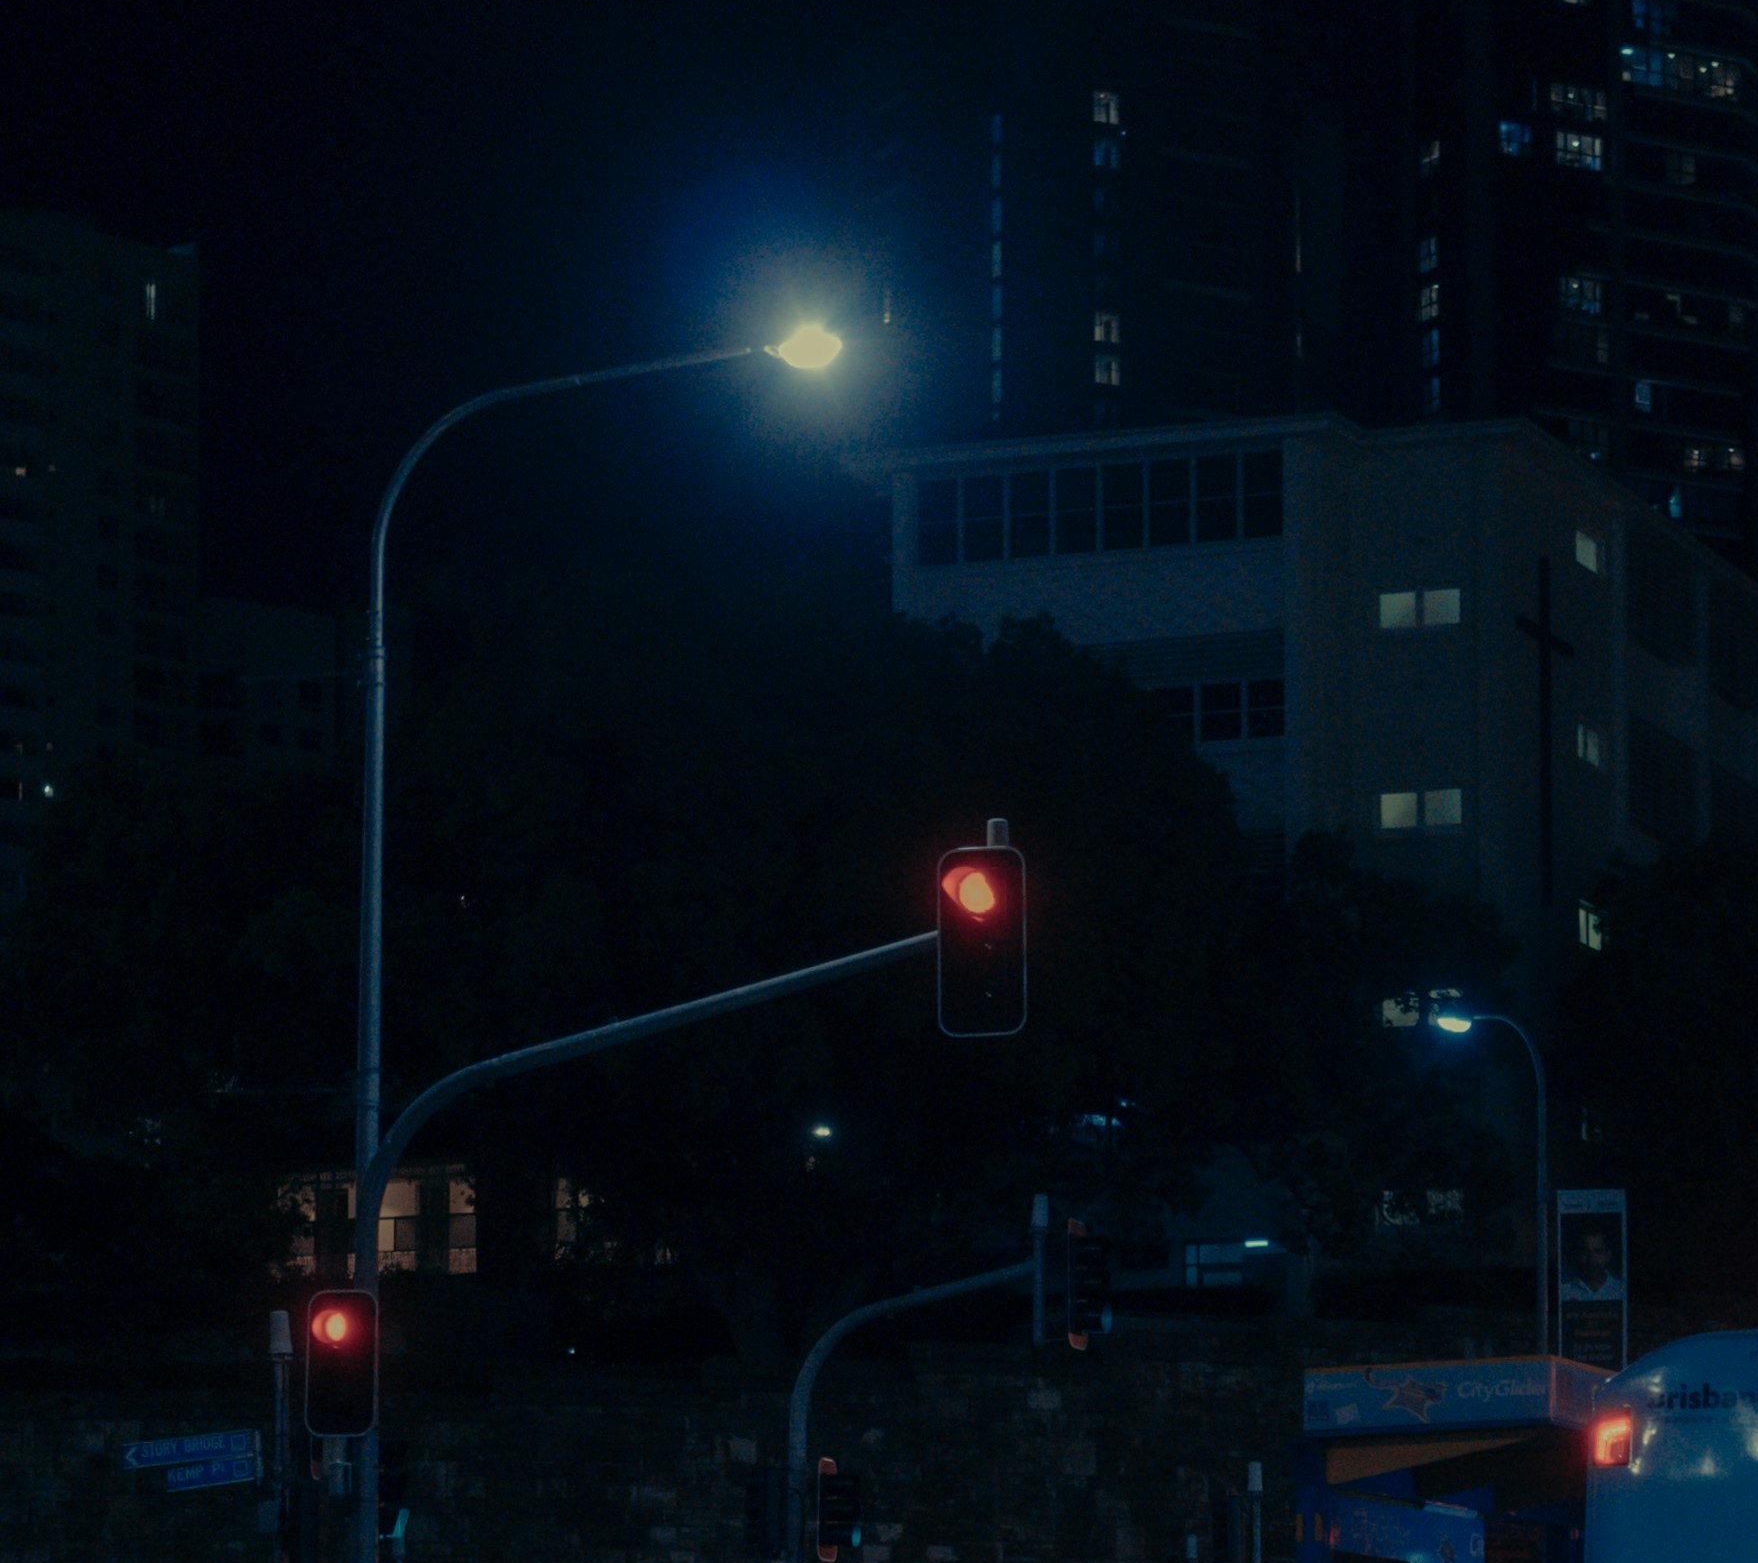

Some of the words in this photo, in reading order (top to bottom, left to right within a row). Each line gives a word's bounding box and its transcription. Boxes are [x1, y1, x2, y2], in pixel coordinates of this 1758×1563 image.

[141, 1440, 177, 1458] STORY
[183, 1434, 226, 1453] BRIDGE
[167, 1464, 205, 1483] KEMP
